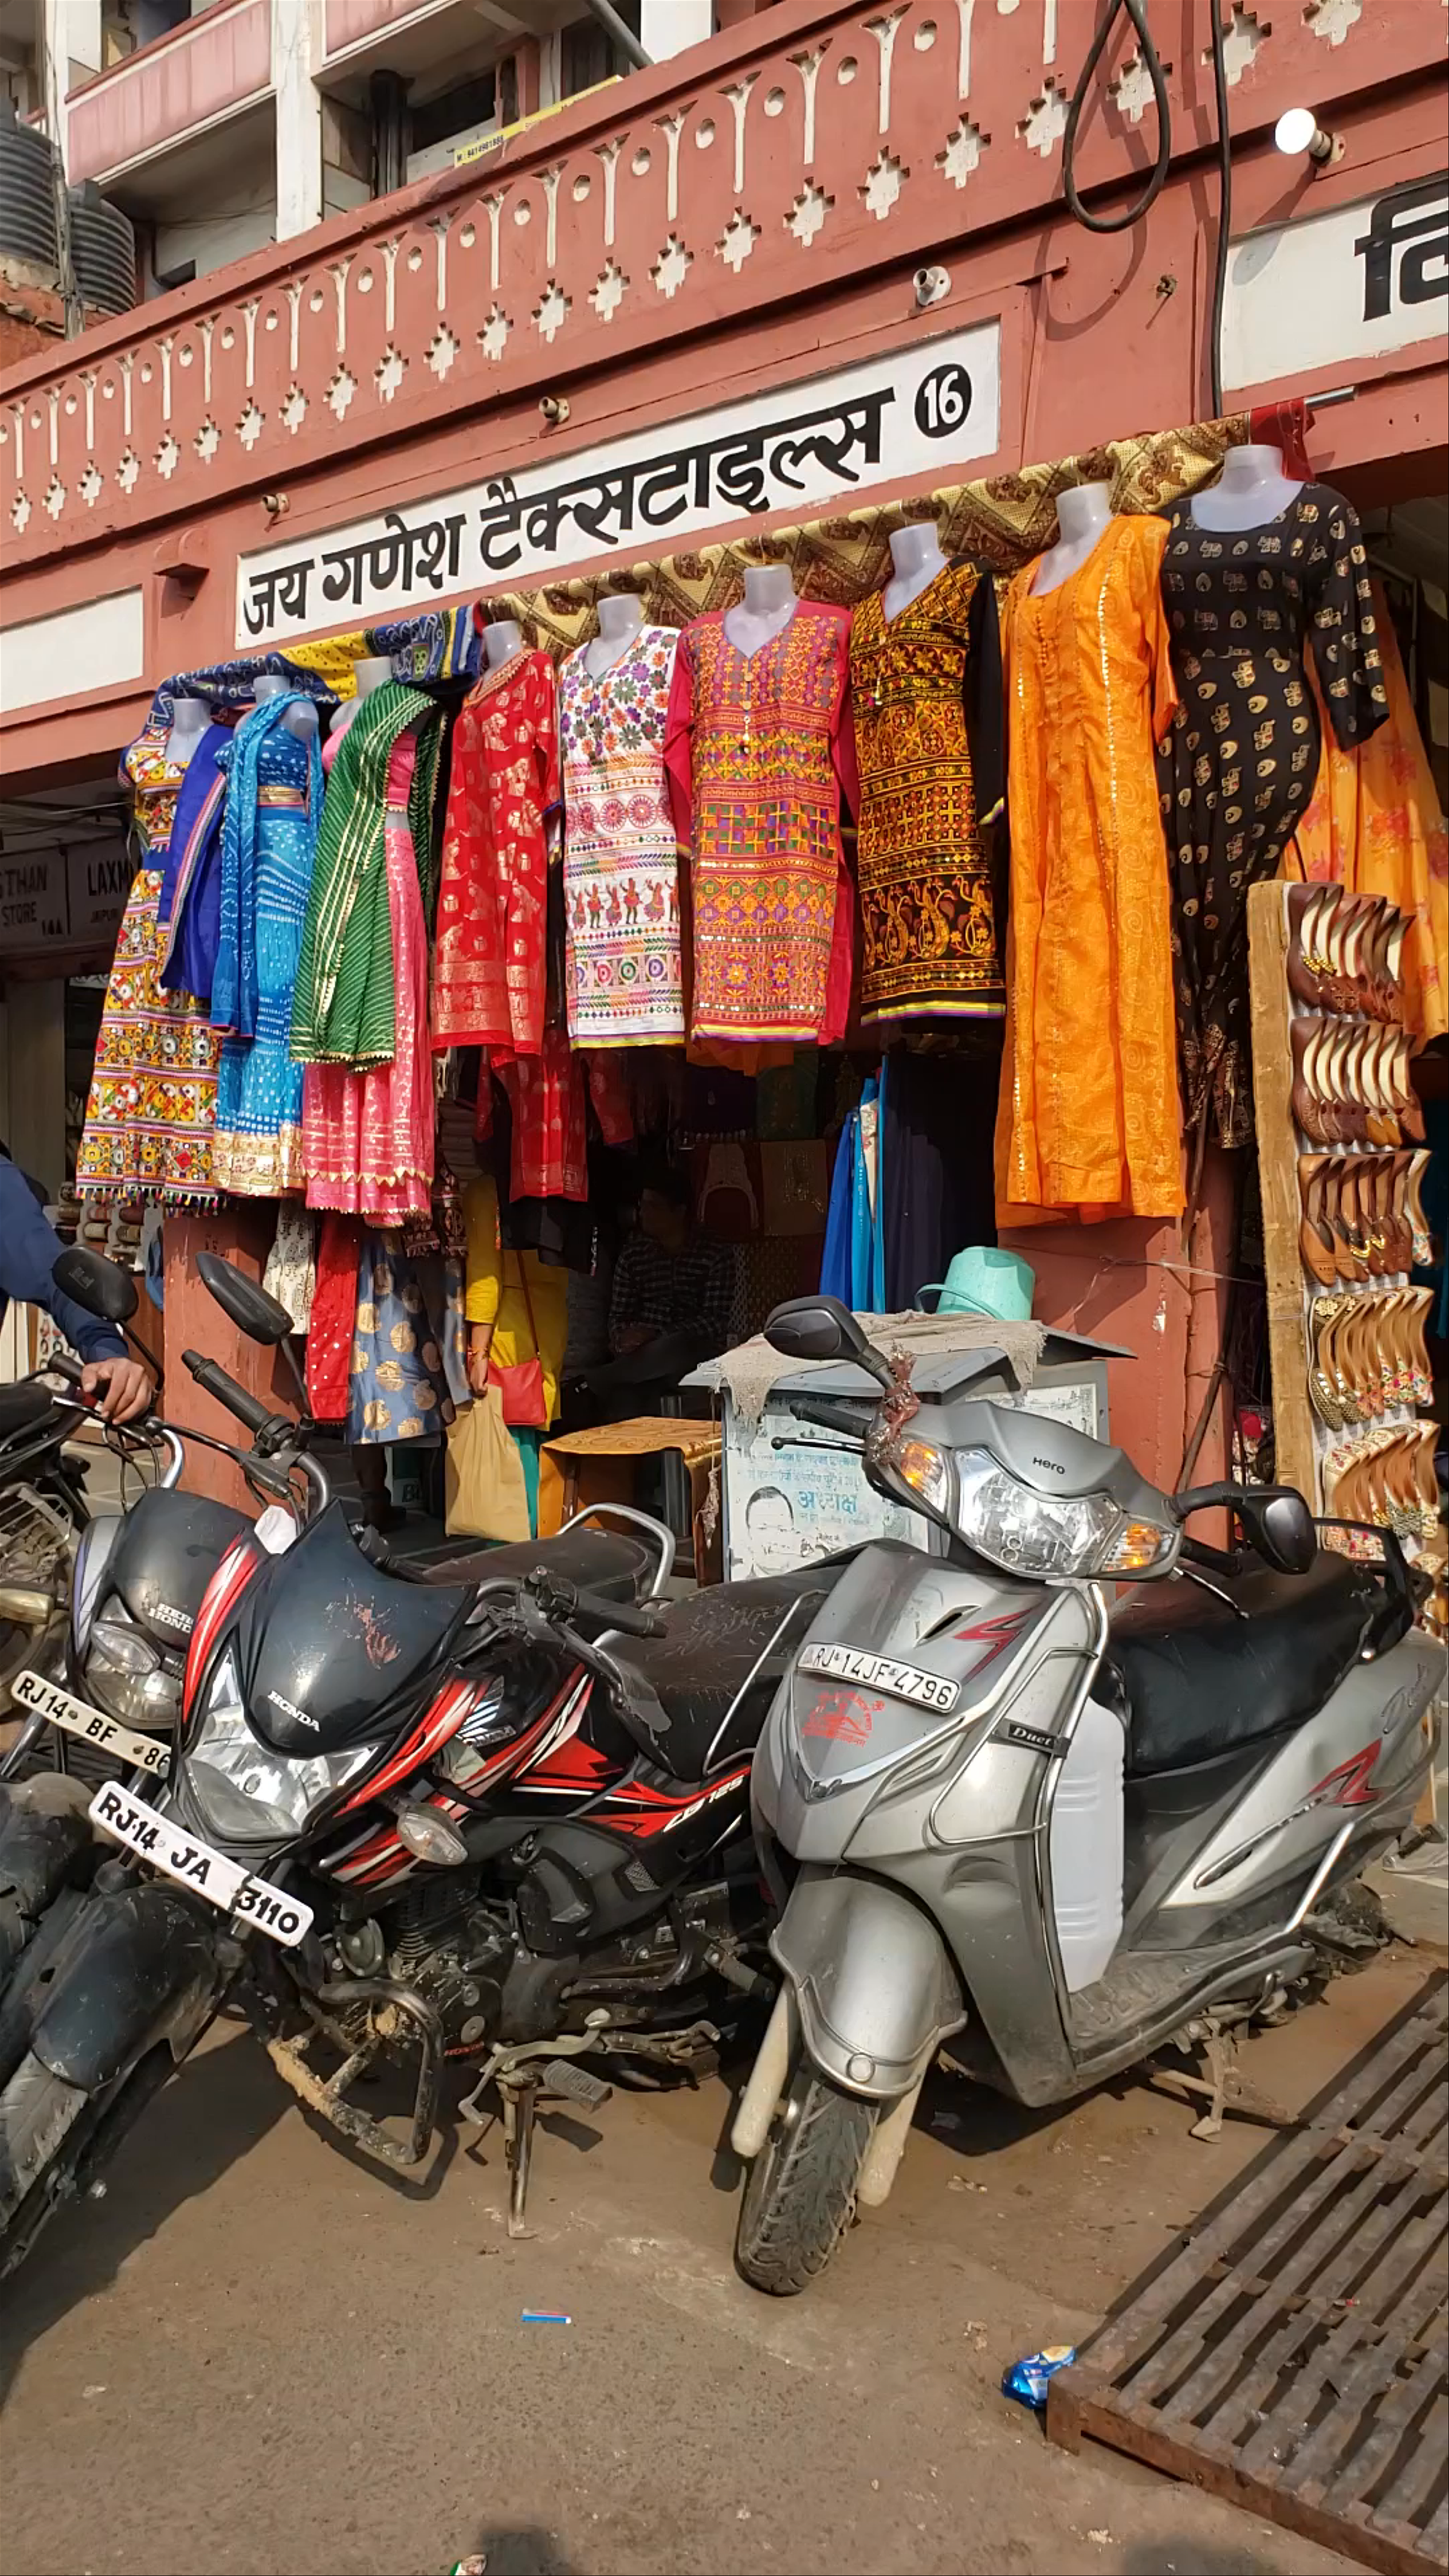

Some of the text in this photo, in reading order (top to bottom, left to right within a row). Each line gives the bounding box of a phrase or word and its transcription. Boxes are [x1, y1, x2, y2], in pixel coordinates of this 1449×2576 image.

[244, 370, 963, 634] जय गणेश टैक्सटाइल्स 16
[1032, 1456, 1065, 1475] Hero
[268, 1690, 320, 1732] HONDA
[86, 1718, 118, 1743] BF
[1013, 1727, 1052, 1746] Duet
[171, 1847, 211, 1885] JA
[237, 1887, 299, 1933] 3110
